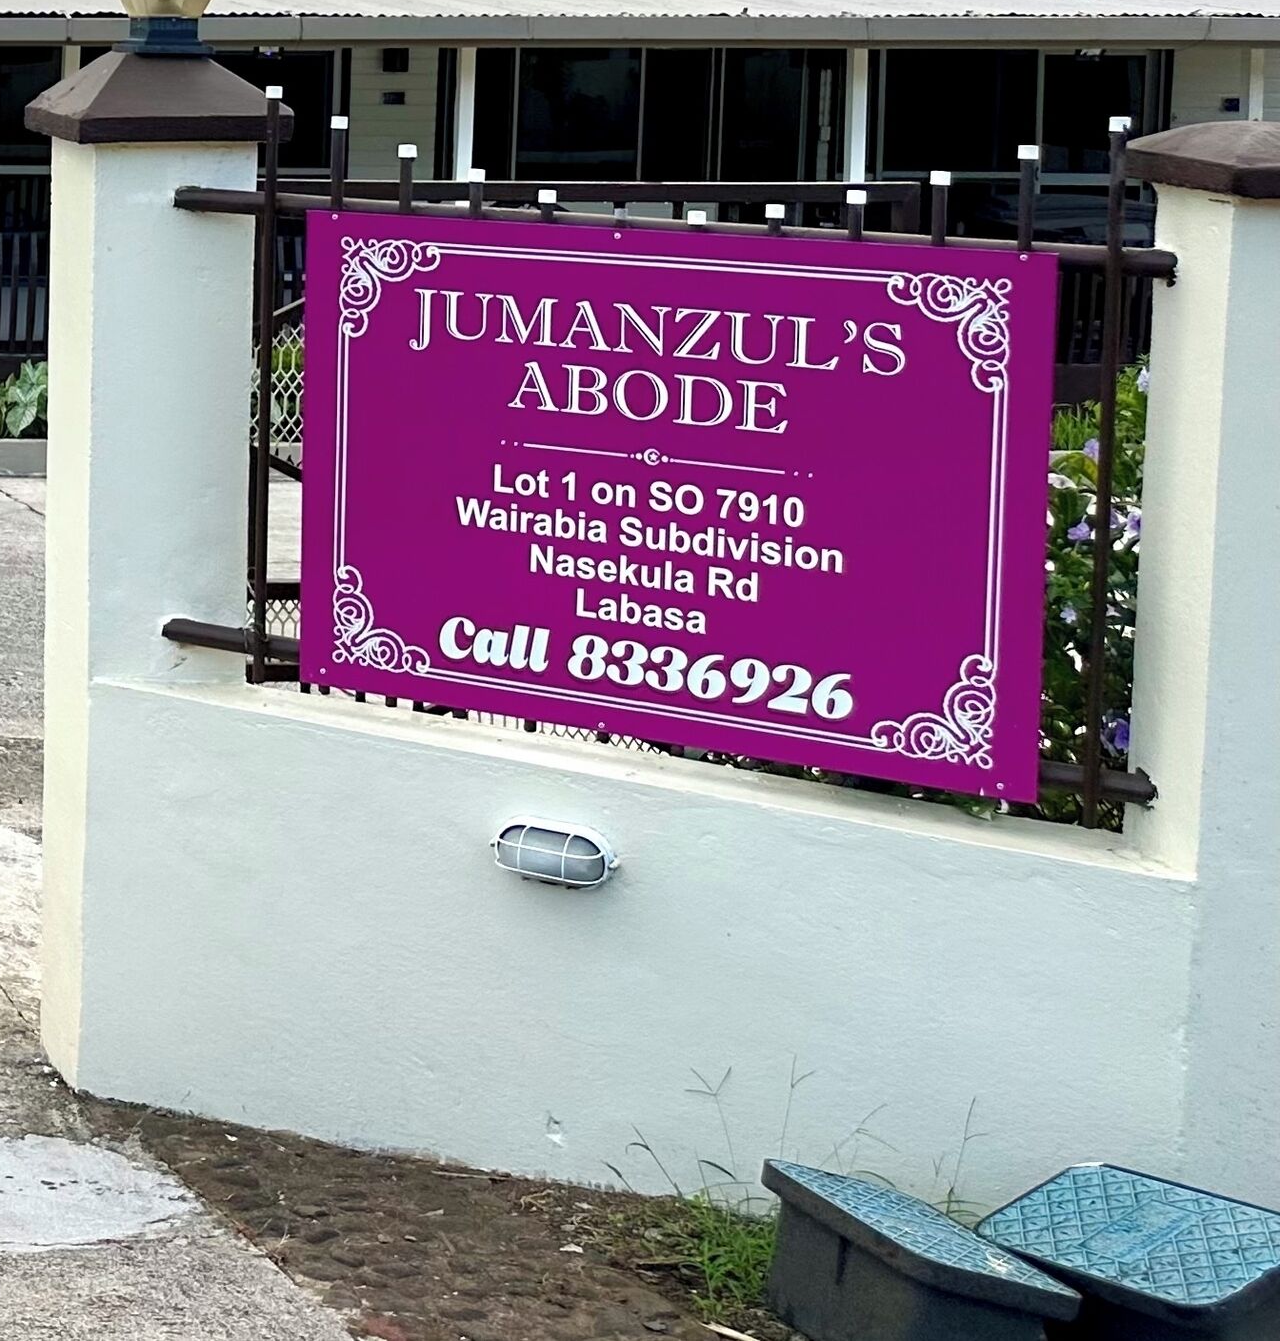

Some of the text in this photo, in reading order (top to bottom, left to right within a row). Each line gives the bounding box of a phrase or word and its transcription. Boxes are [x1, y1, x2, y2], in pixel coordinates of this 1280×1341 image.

[409, 288, 906, 376] JUMANZUL'S
[507, 361, 788, 434] ABODE
[493, 463, 805, 528] Lot 1 on SO 7910
[455, 496, 843, 574] Wairabia Subdivision
[529, 543, 759, 603] Nasekula Rd
[575, 587, 707, 635] Labasa
[439, 616, 854, 720] Call 8336926
